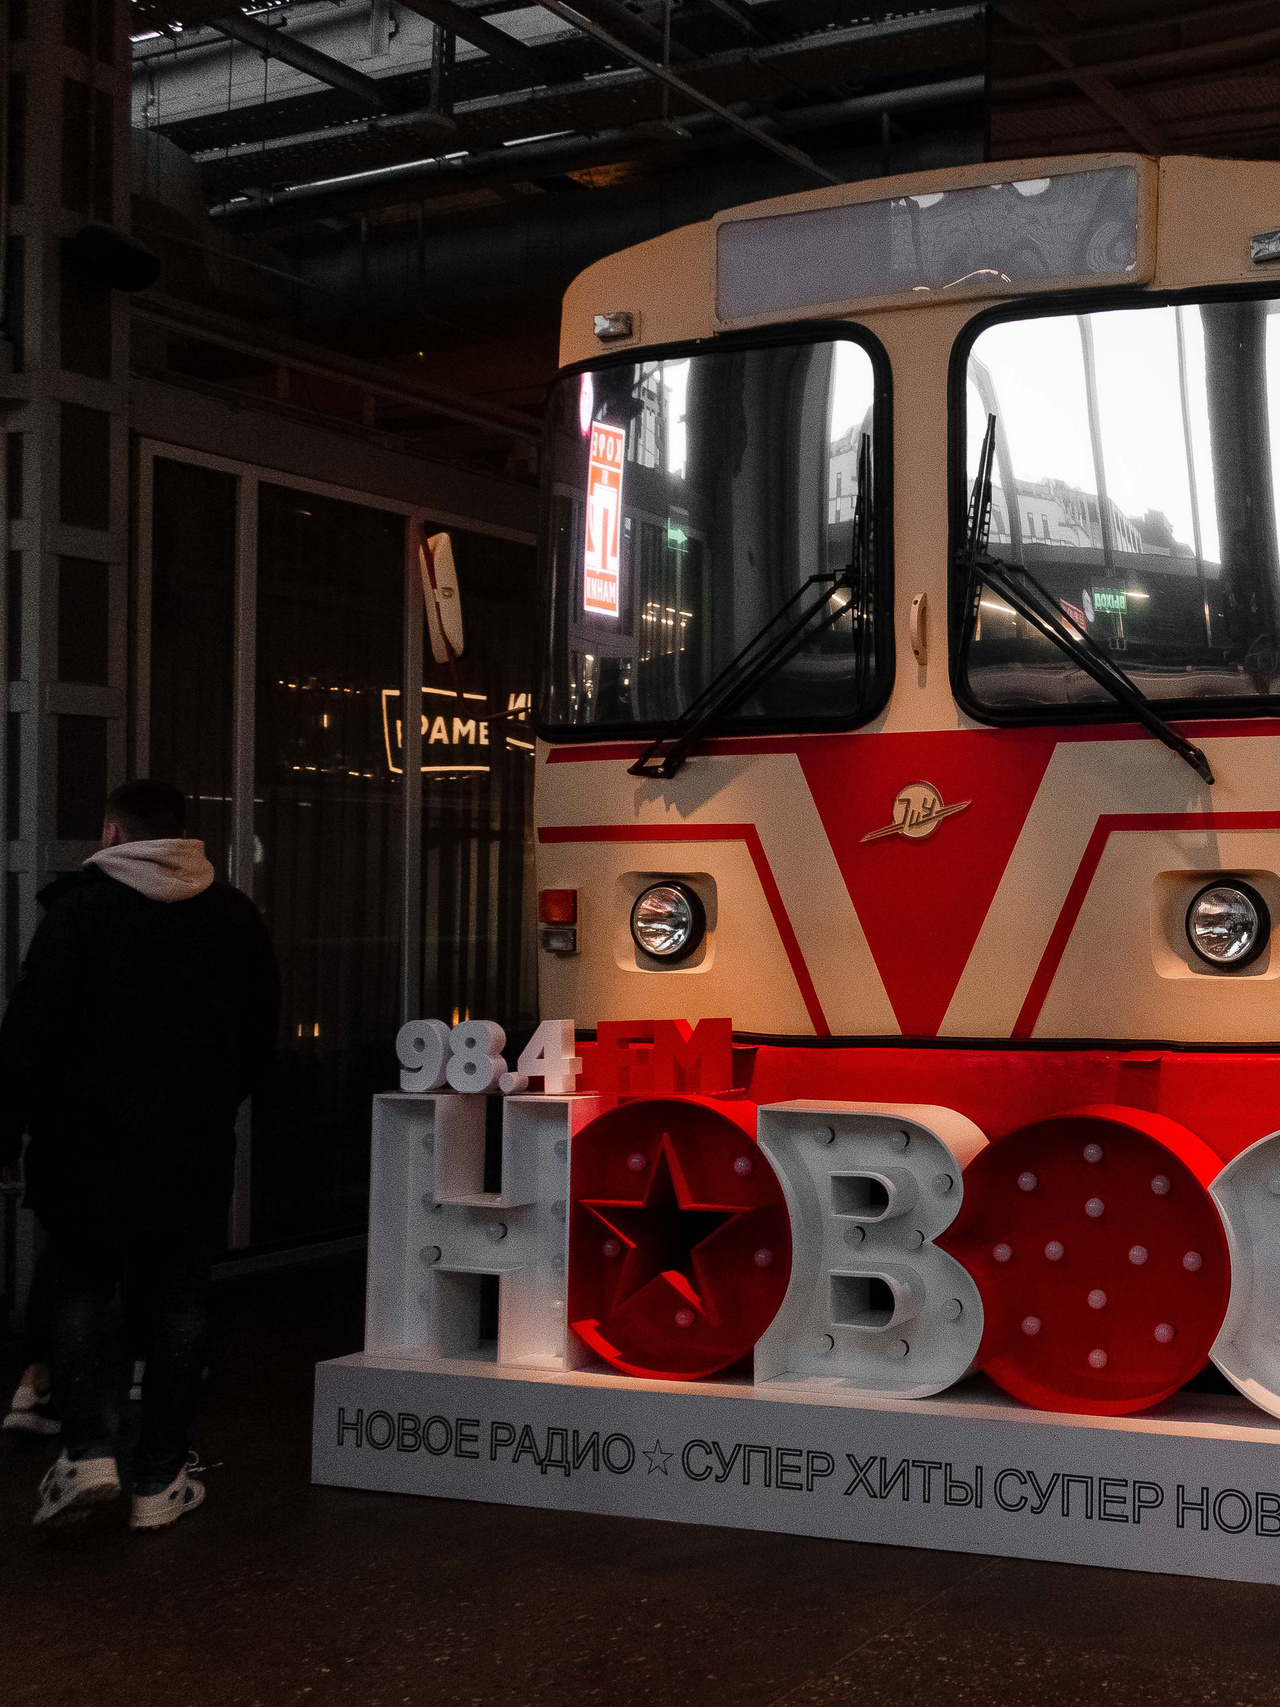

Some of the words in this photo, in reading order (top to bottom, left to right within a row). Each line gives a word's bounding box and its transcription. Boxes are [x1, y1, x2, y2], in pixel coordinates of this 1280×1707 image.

[396, 1018, 583, 1094] 98.4
[596, 1017, 734, 1095] FM
[335, 1406, 482, 1460] НОВОЕ
[488, 1421, 636, 1477] РАДИО
[680, 1438, 836, 1493] СУПЕР
[843, 1453, 984, 1509] ХИТЫ
[992, 1467, 1165, 1525] СУПЕР
